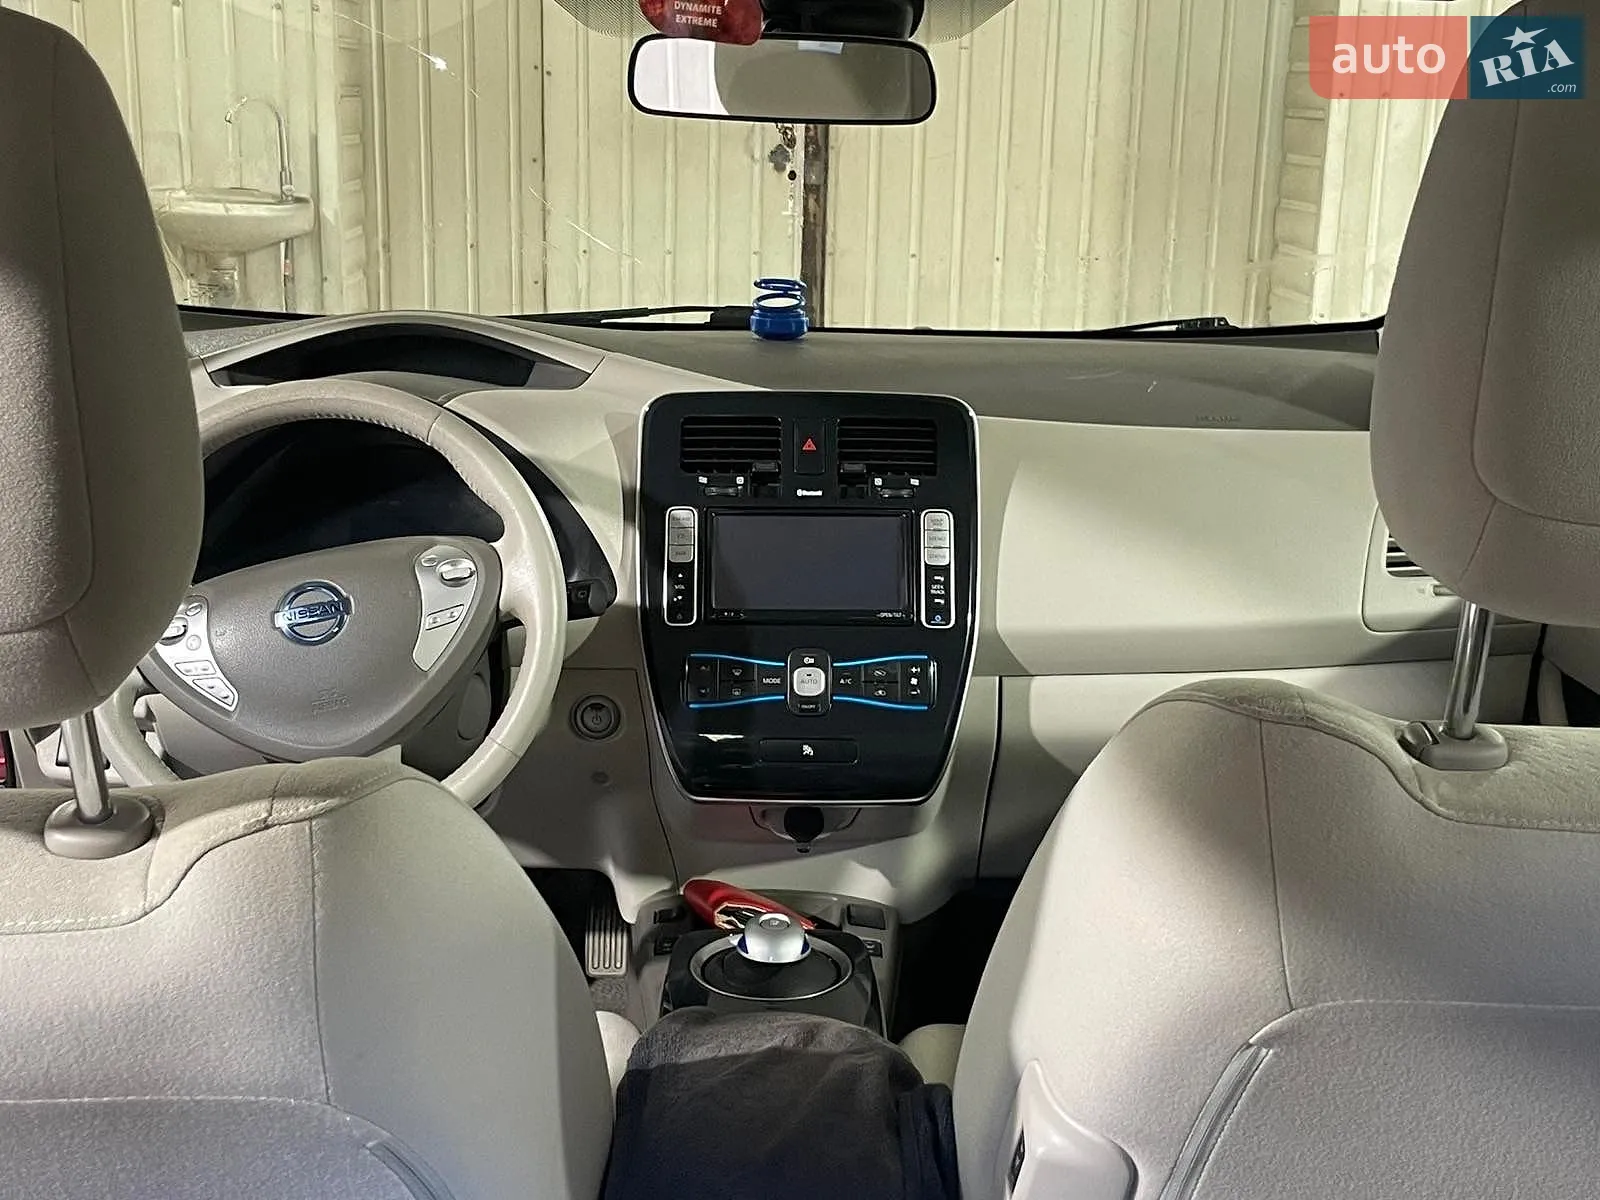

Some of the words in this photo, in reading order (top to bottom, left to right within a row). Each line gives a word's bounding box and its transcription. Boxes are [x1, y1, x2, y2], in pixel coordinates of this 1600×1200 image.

[674, 1, 722, 15] DYNAMITE
[675, 14, 718, 28] EXTREME
[283, 600, 344, 621] NISSAN
[762, 677, 782, 685] MODE
